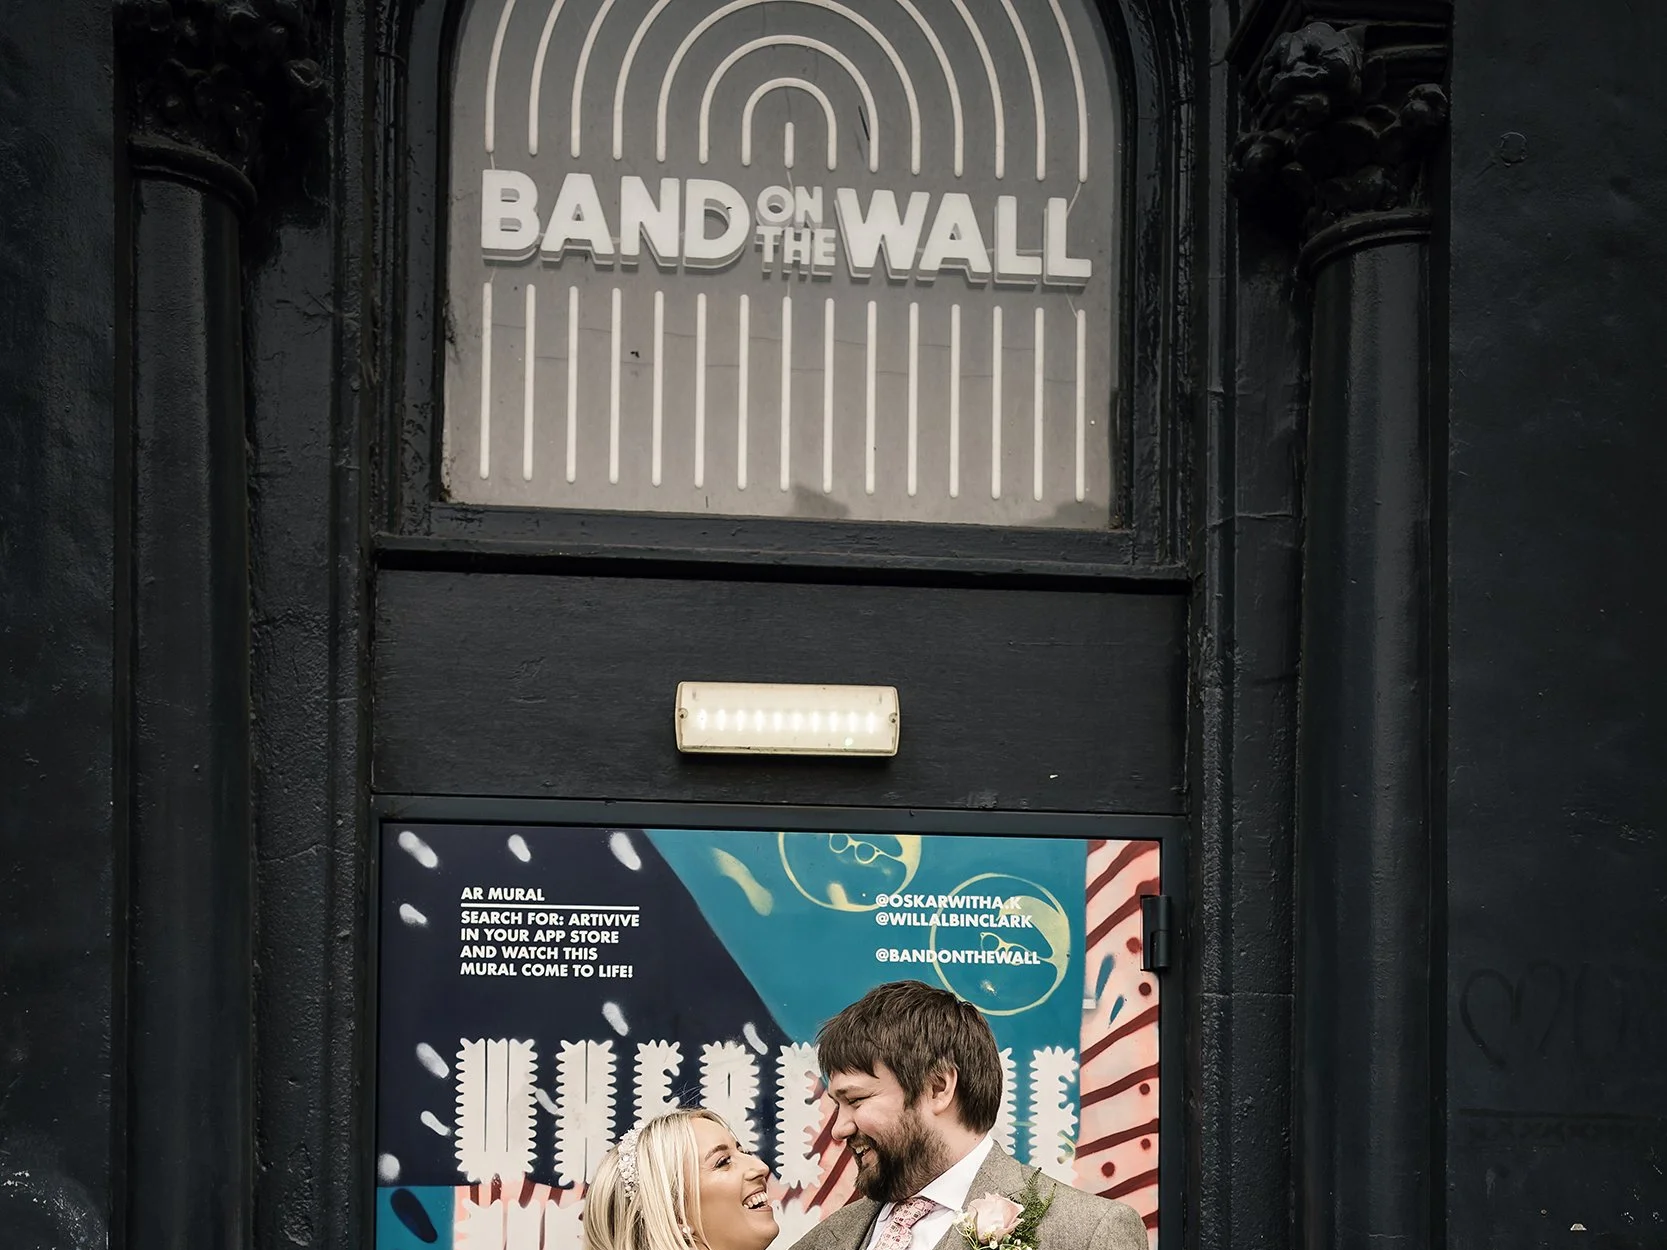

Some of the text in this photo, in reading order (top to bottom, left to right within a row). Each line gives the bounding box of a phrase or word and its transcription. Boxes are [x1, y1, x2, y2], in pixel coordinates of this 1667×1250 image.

[481, 169, 1093, 287] BAND ON THE WALL
[460, 886, 545, 901] AR MURAL
[875, 893, 1022, 910] @OSKARWITHA.K
[460, 910, 640, 928] SEARCH FOR: ARTIVIVE
[875, 911, 1033, 928] @WILLALBINCLARK
[460, 927, 619, 944] IN YOUR APP STORE
[460, 945, 598, 961] AND WATCH THIS
[875, 948, 1041, 965] @BANDONTHEWALL
[460, 962, 634, 979] MURAL COME TO LIFE!
